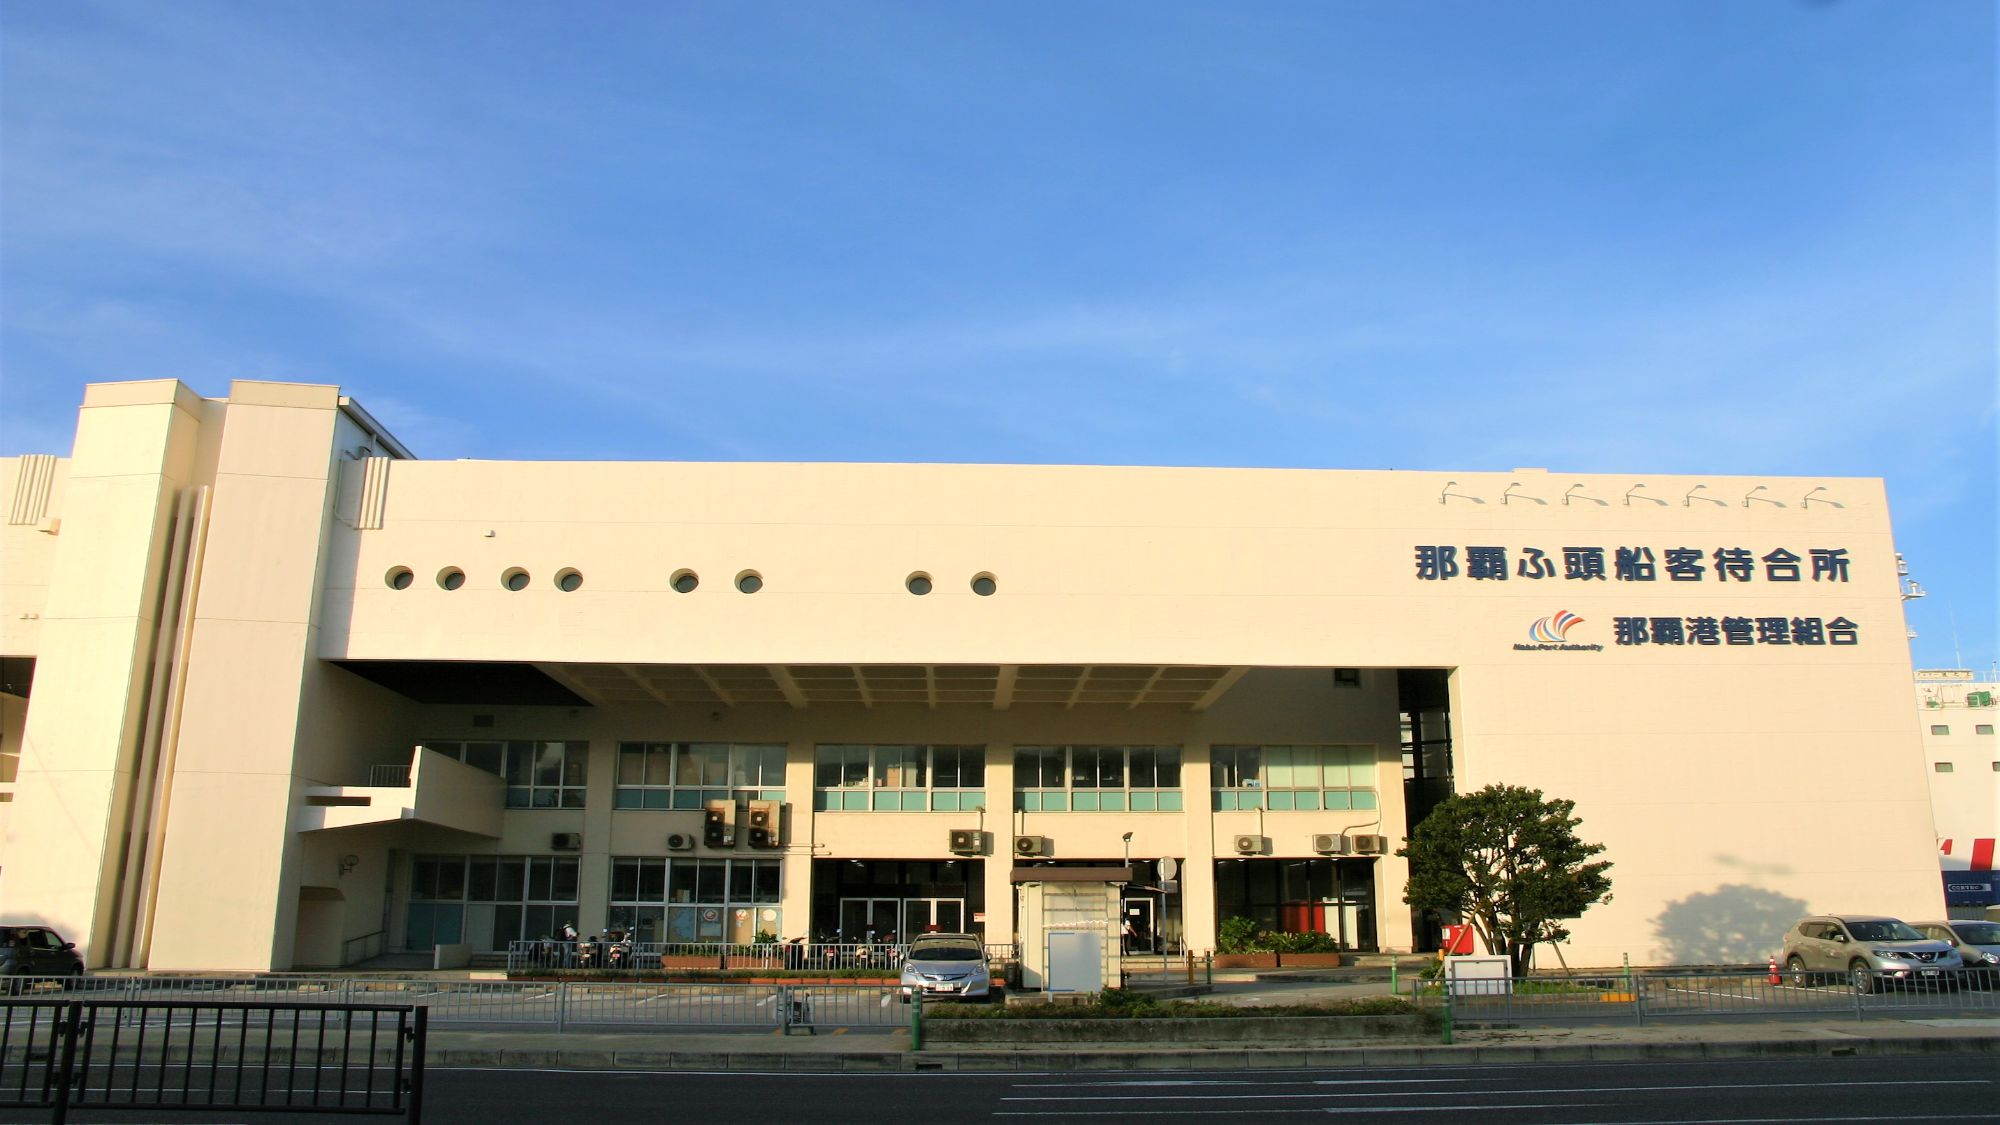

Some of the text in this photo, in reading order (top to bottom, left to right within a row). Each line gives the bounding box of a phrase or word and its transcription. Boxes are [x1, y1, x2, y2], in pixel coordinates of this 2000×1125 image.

[1414, 545, 1850, 582] 那覇ふ頭船客待合所
[1612, 616, 1859, 646] 那覇港管理組合
[1559, 644, 1603, 652] Authority
